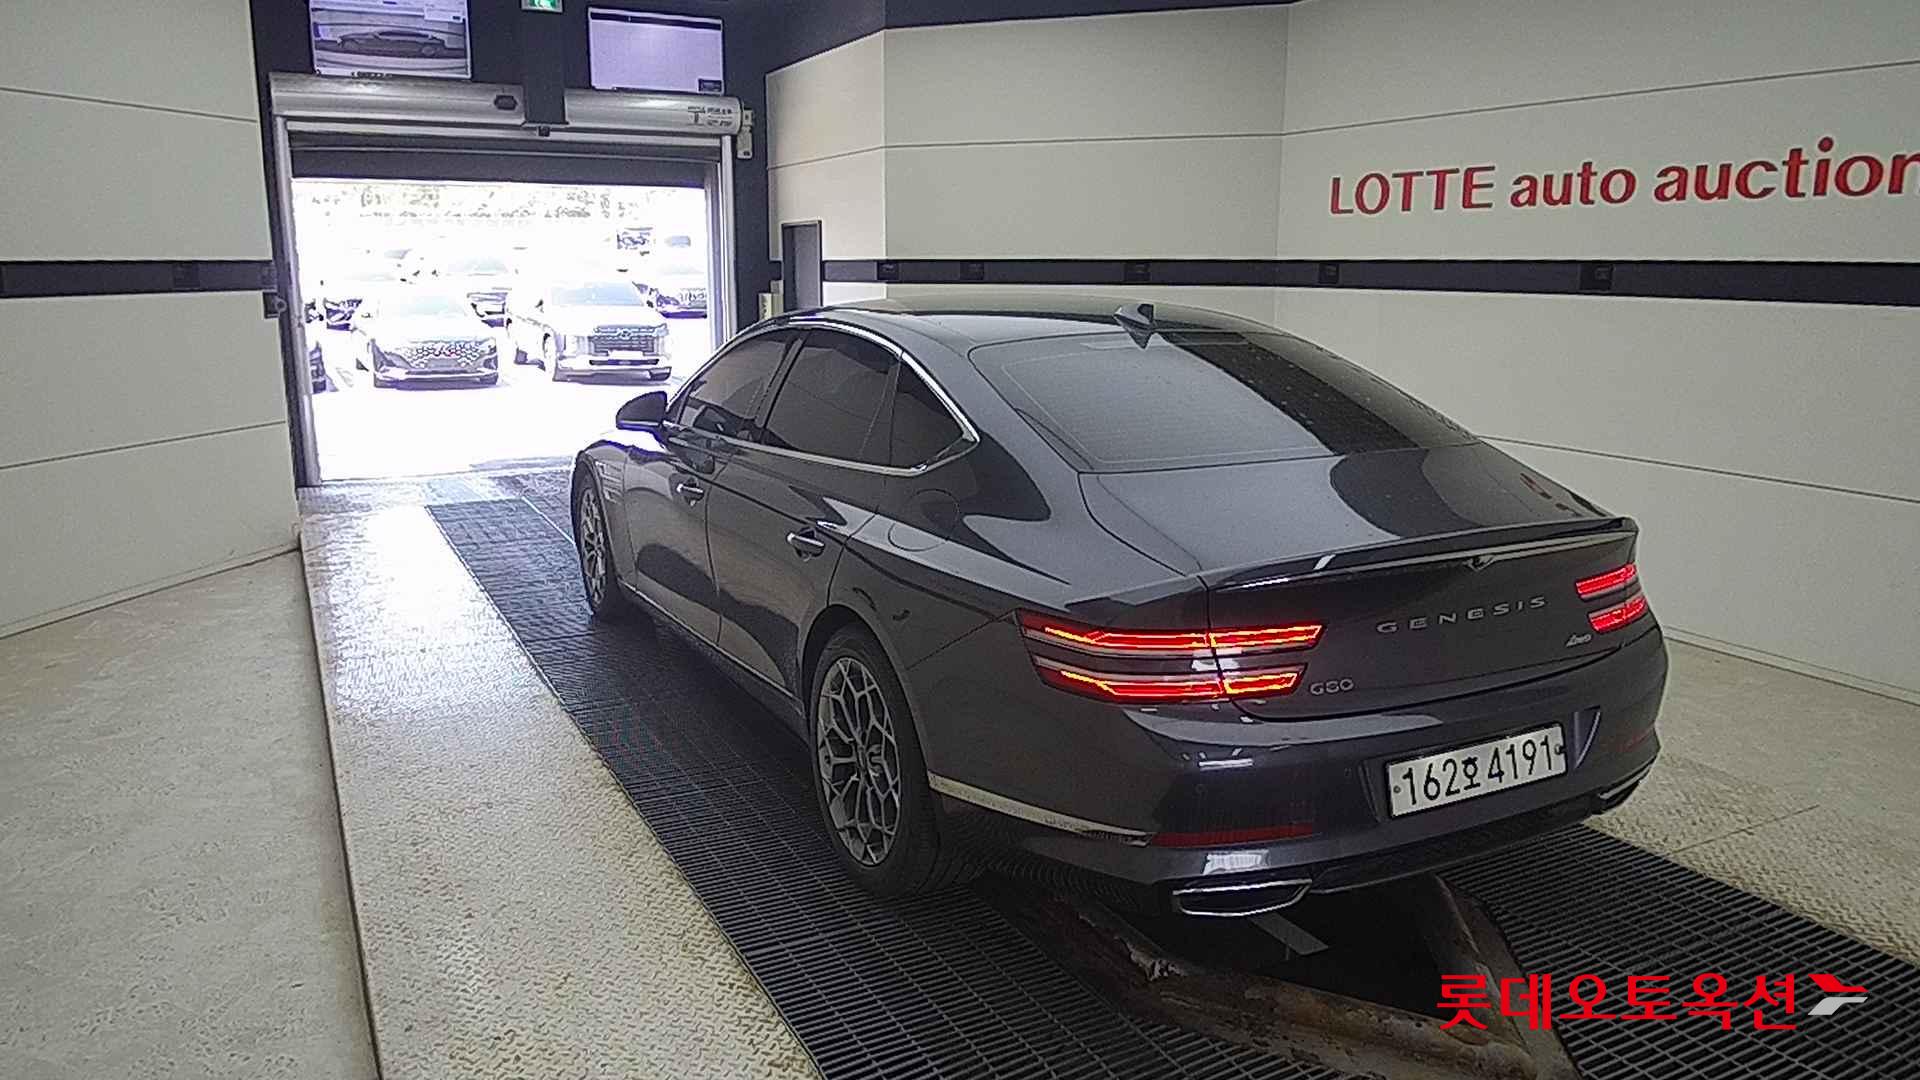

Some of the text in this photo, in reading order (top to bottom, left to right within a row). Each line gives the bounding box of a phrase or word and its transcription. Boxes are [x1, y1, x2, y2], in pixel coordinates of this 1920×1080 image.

[1330, 165, 1496, 214] LOTTE
[1510, 161, 1637, 208] auto
[1376, 596, 1546, 633] GENESIS
[1310, 678, 1354, 695] G80
